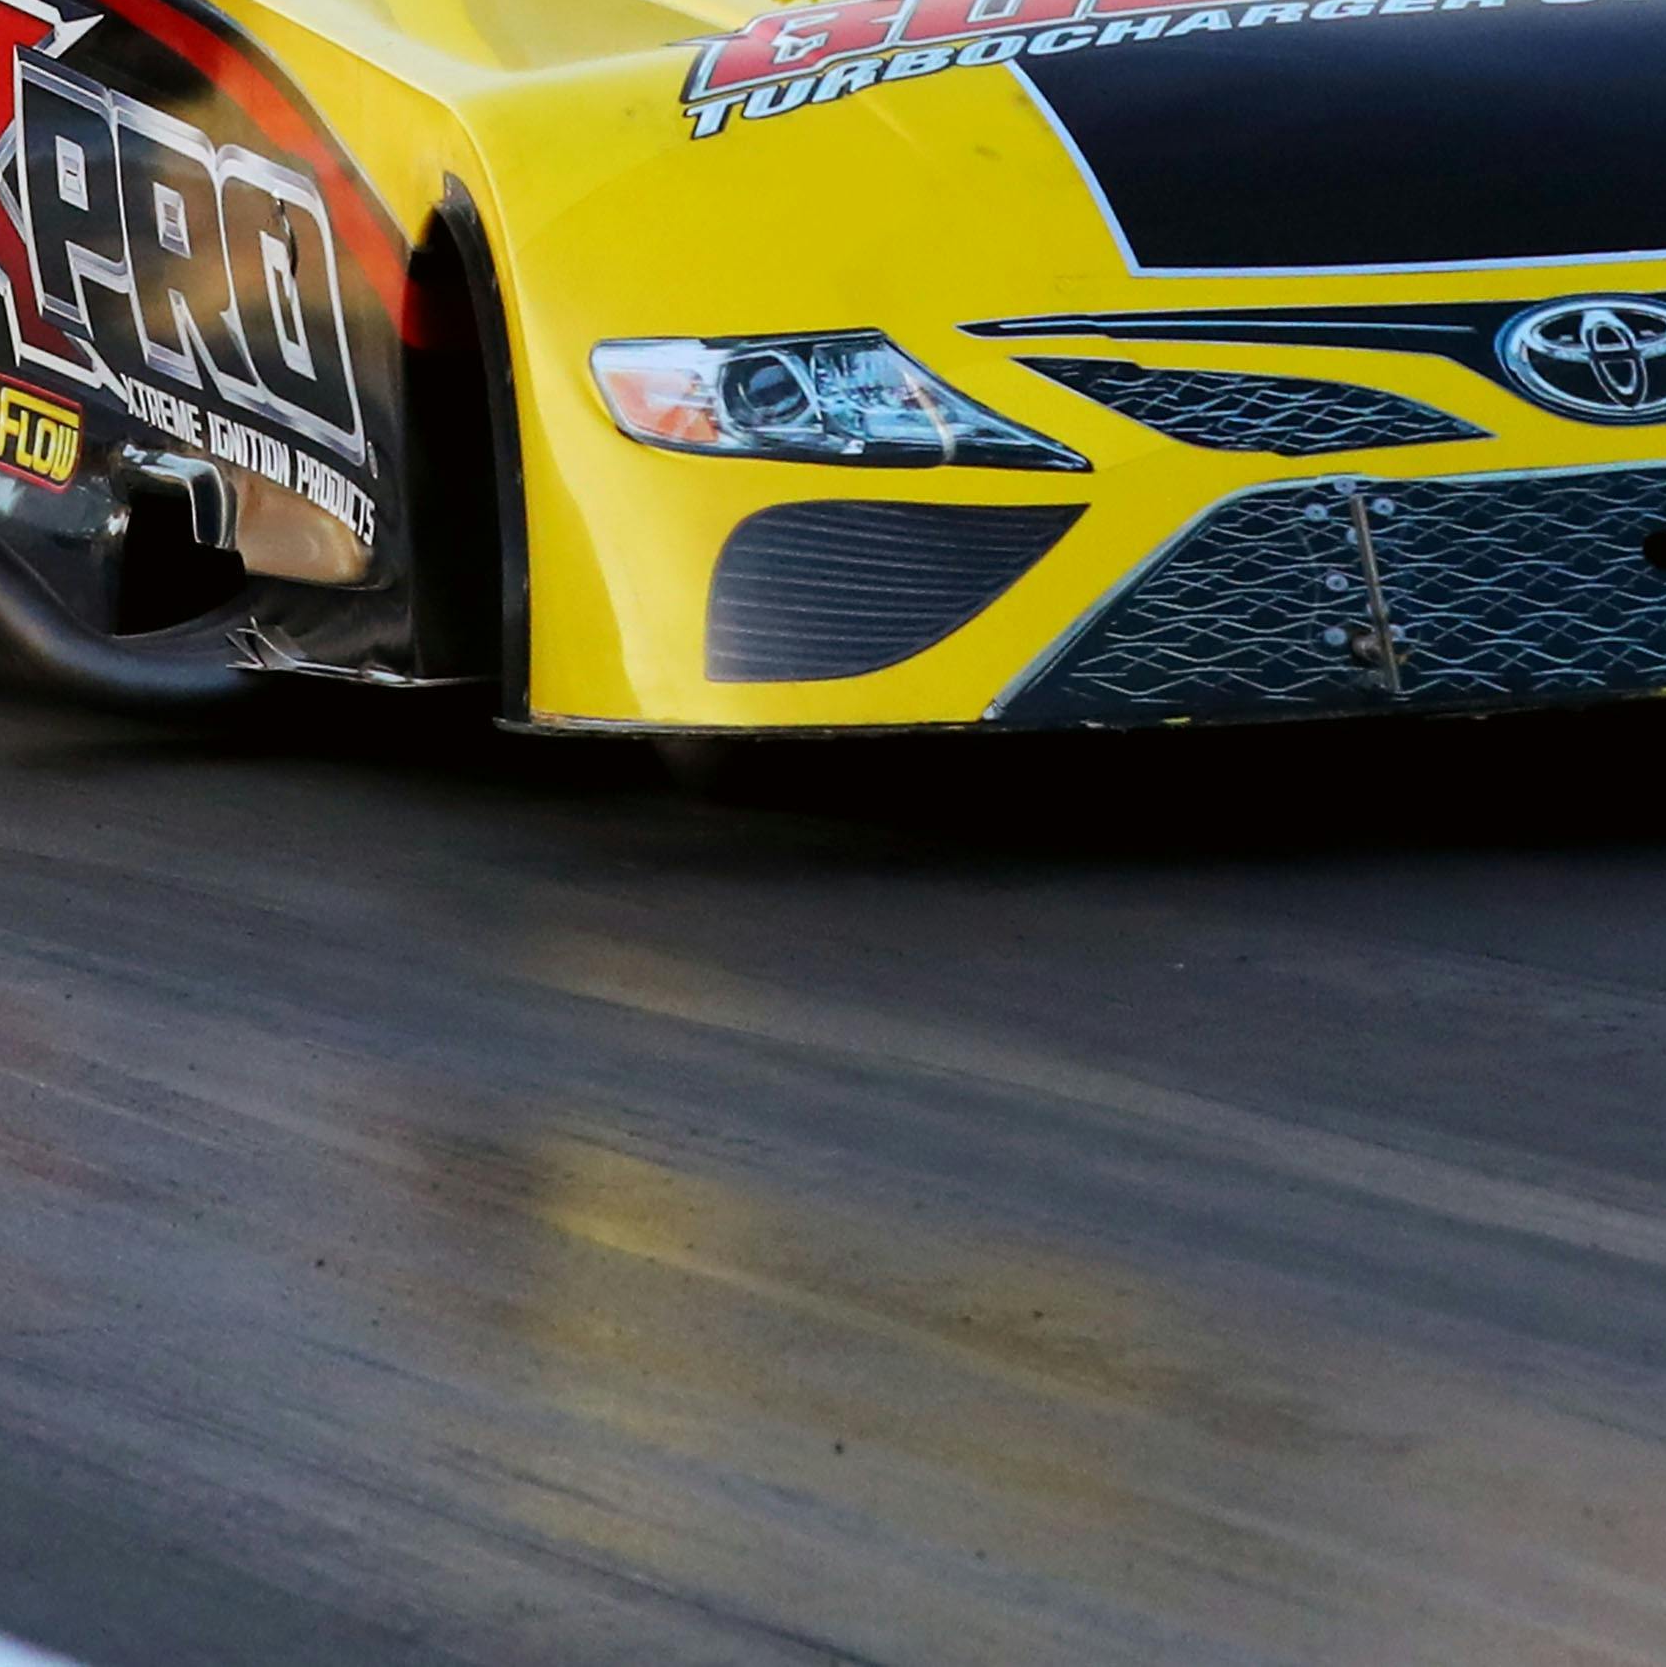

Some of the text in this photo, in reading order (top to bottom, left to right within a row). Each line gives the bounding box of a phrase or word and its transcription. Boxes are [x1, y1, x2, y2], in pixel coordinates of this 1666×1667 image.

[120, 372, 376, 547] XTREME IGNITION PRODUCTS
